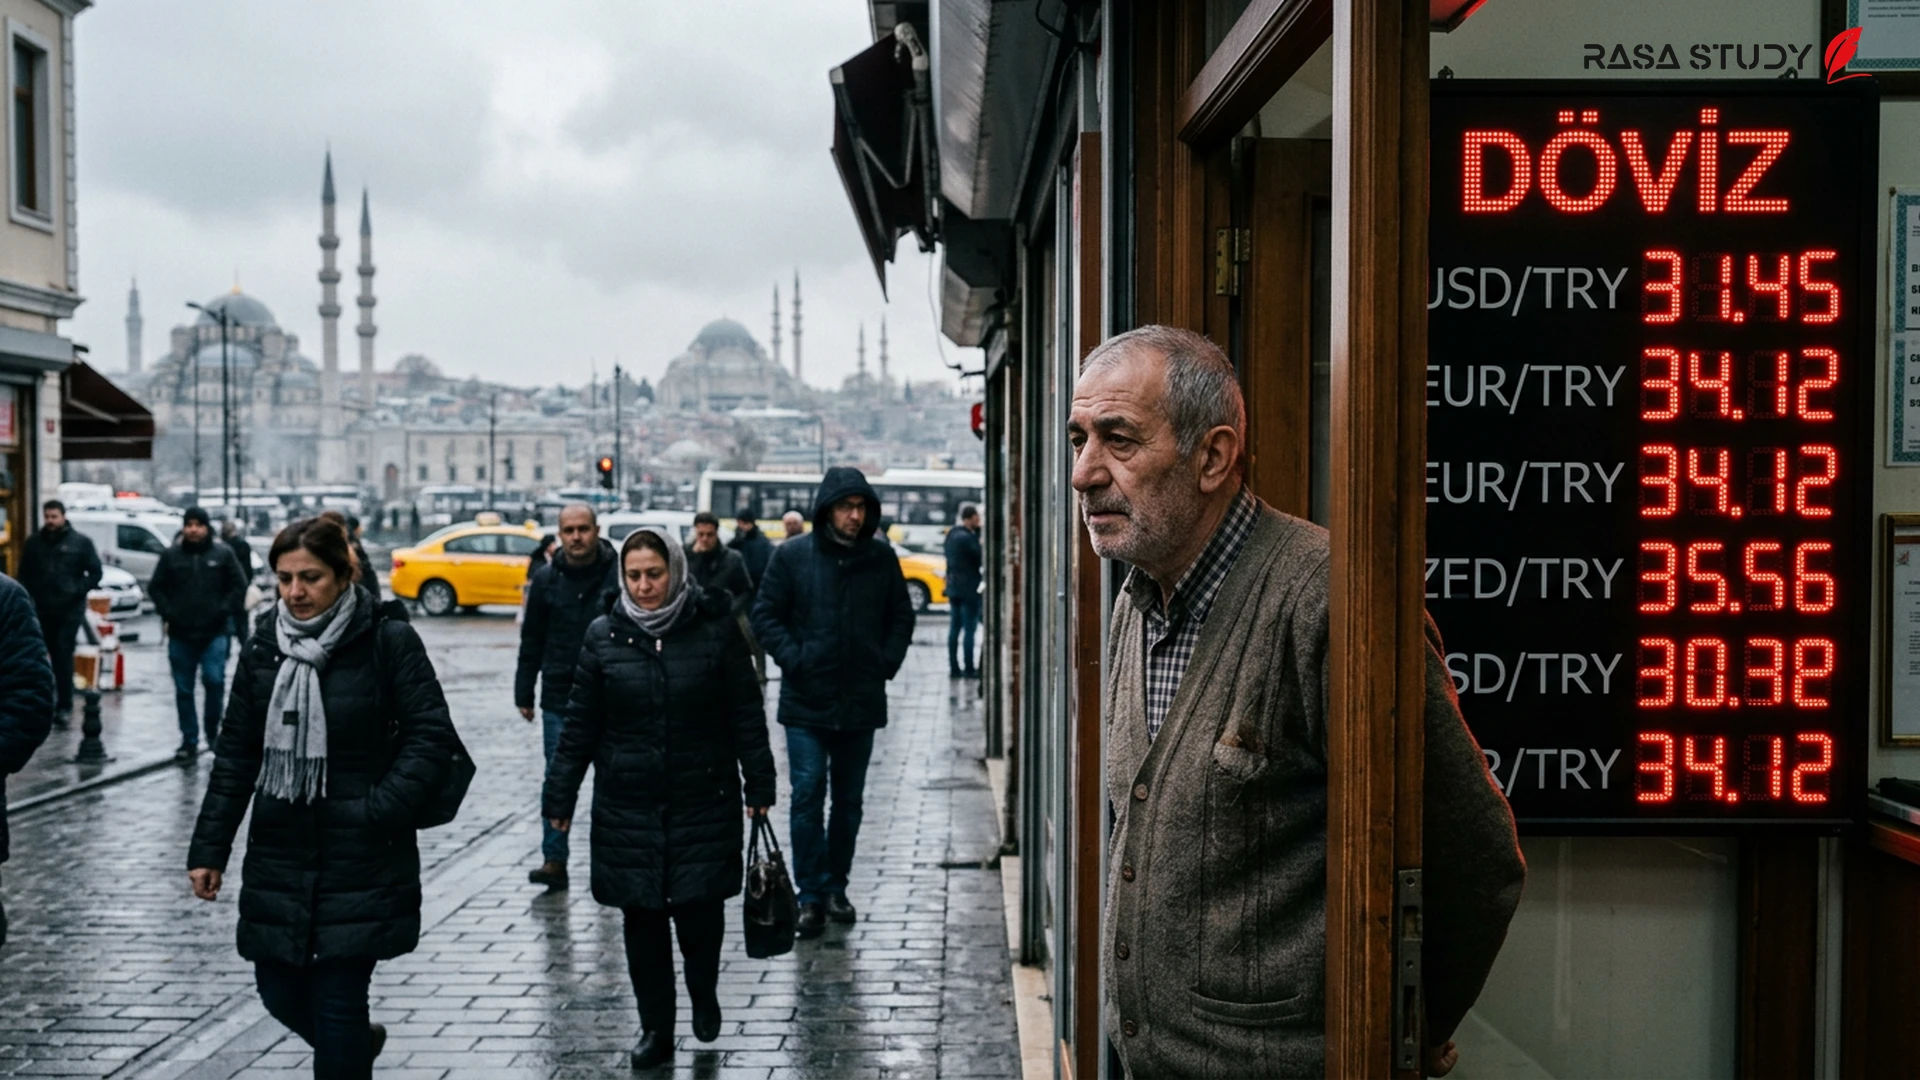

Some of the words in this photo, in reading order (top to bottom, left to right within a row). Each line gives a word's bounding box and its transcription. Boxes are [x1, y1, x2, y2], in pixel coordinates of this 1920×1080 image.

[1464, 108, 1790, 212] DÖVİZ
[1643, 250, 1840, 323] 31.45
[1642, 347, 1838, 421] 34.12
[1640, 444, 1837, 518] 34.12
[1638, 541, 1836, 613] 35.56
[1444, 651, 1624, 703] SD/TRY
[1636, 733, 1833, 803] 34.12
